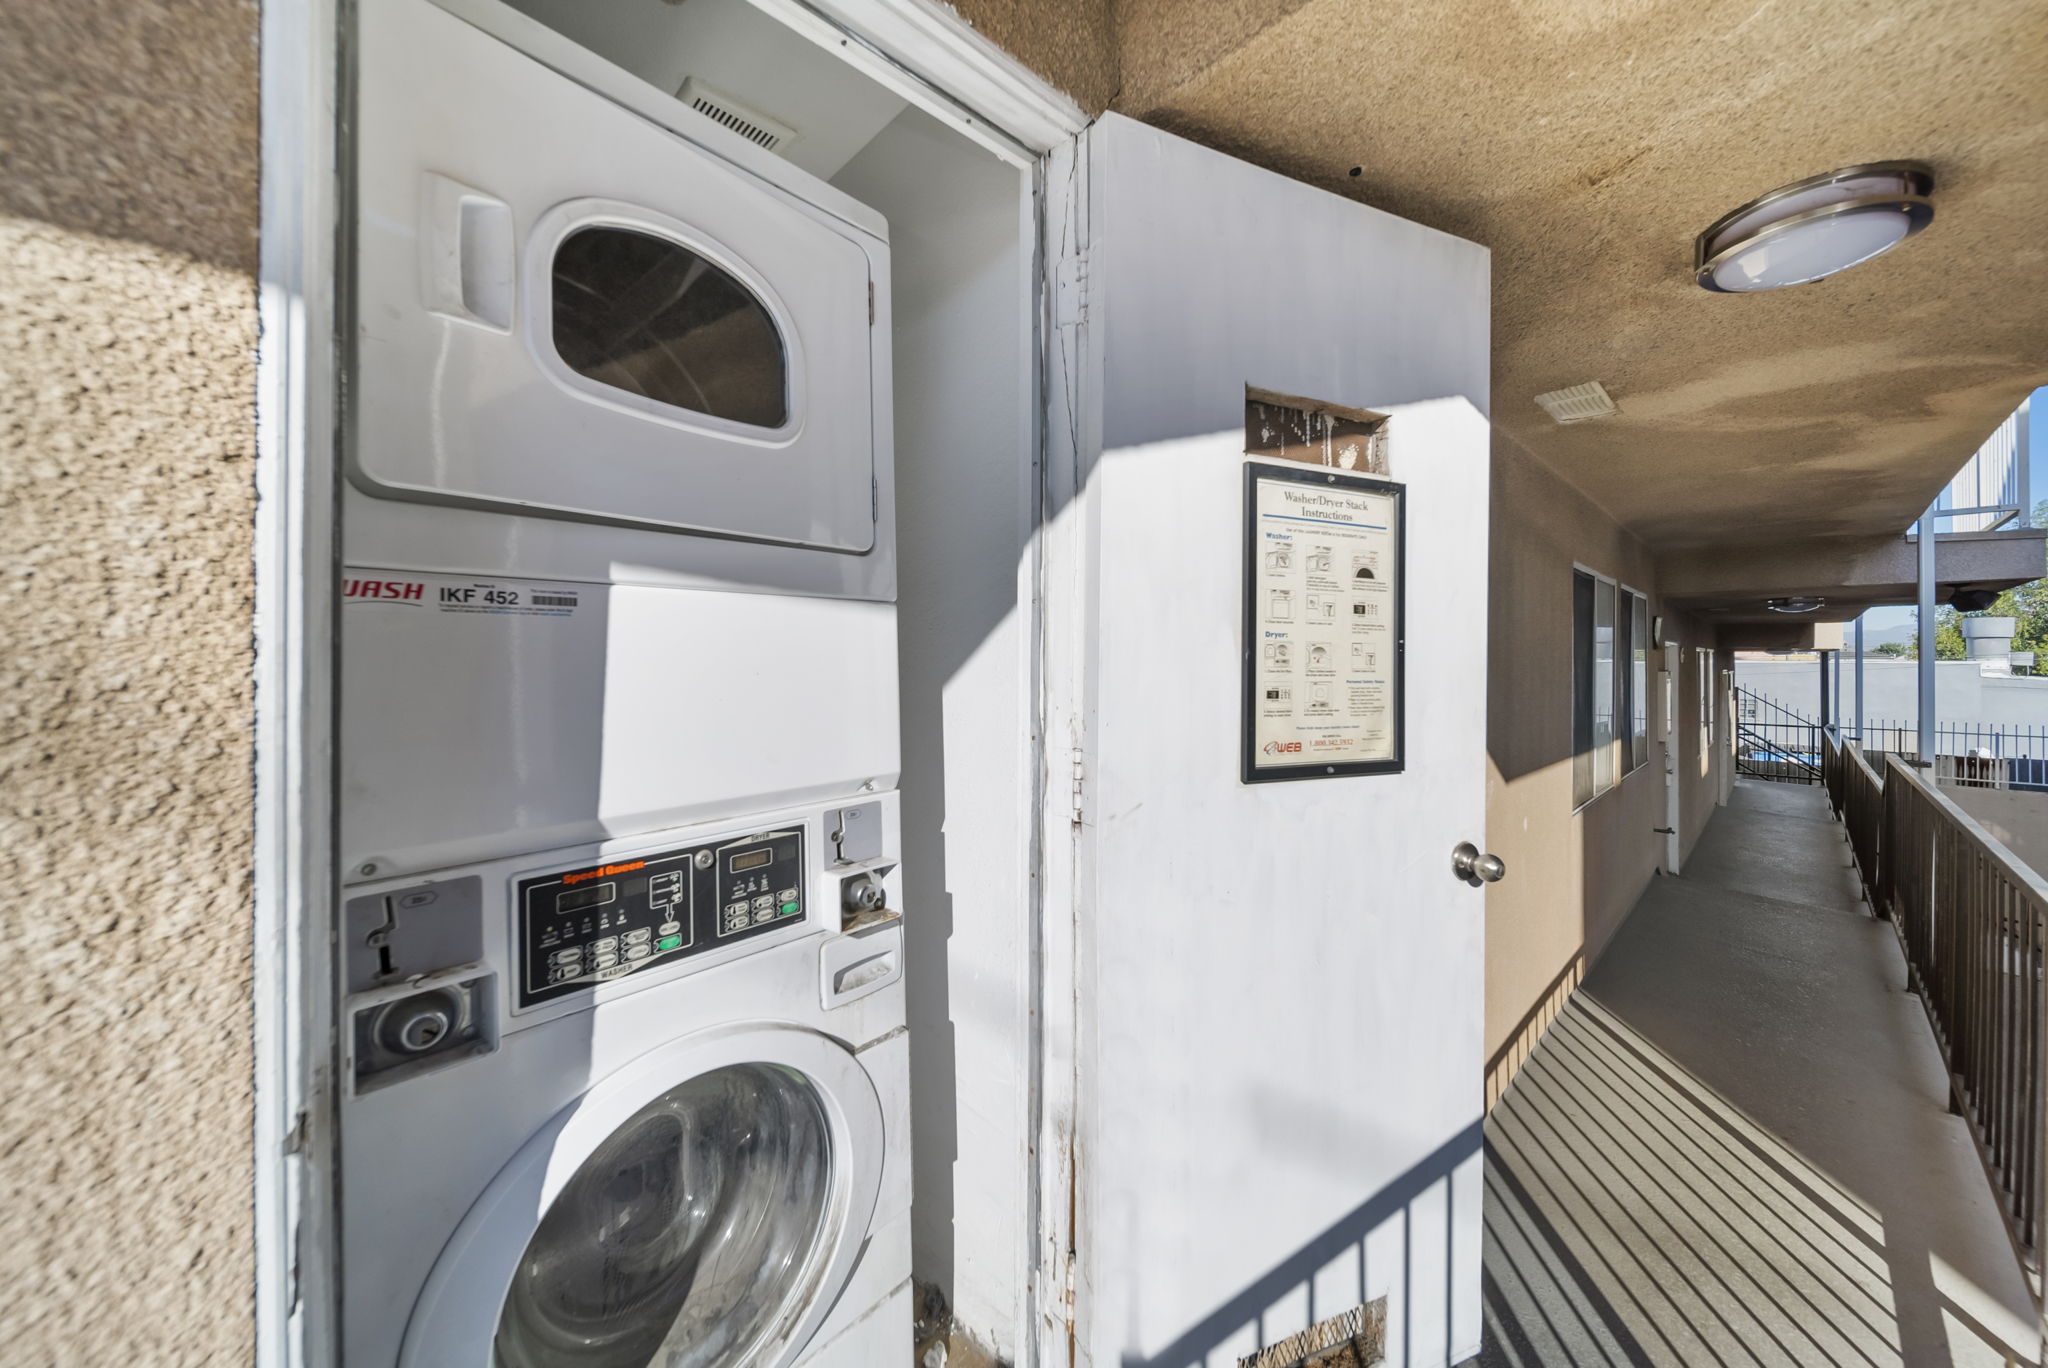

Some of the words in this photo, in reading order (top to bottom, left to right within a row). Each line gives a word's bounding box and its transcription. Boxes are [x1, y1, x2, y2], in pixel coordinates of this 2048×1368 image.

[1284, 491, 1344, 508] Washer/Dryer
[1346, 500, 1369, 511] Stack
[1302, 506, 1353, 521] Instructions
[1265, 532, 1293, 541] Washer:
[440, 587, 476, 602] IKF
[483, 590, 519, 605] 452
[1264, 631, 1289, 639] Dryer:
[751, 832, 770, 842] DRYER
[601, 963, 633, 978] WASHER
